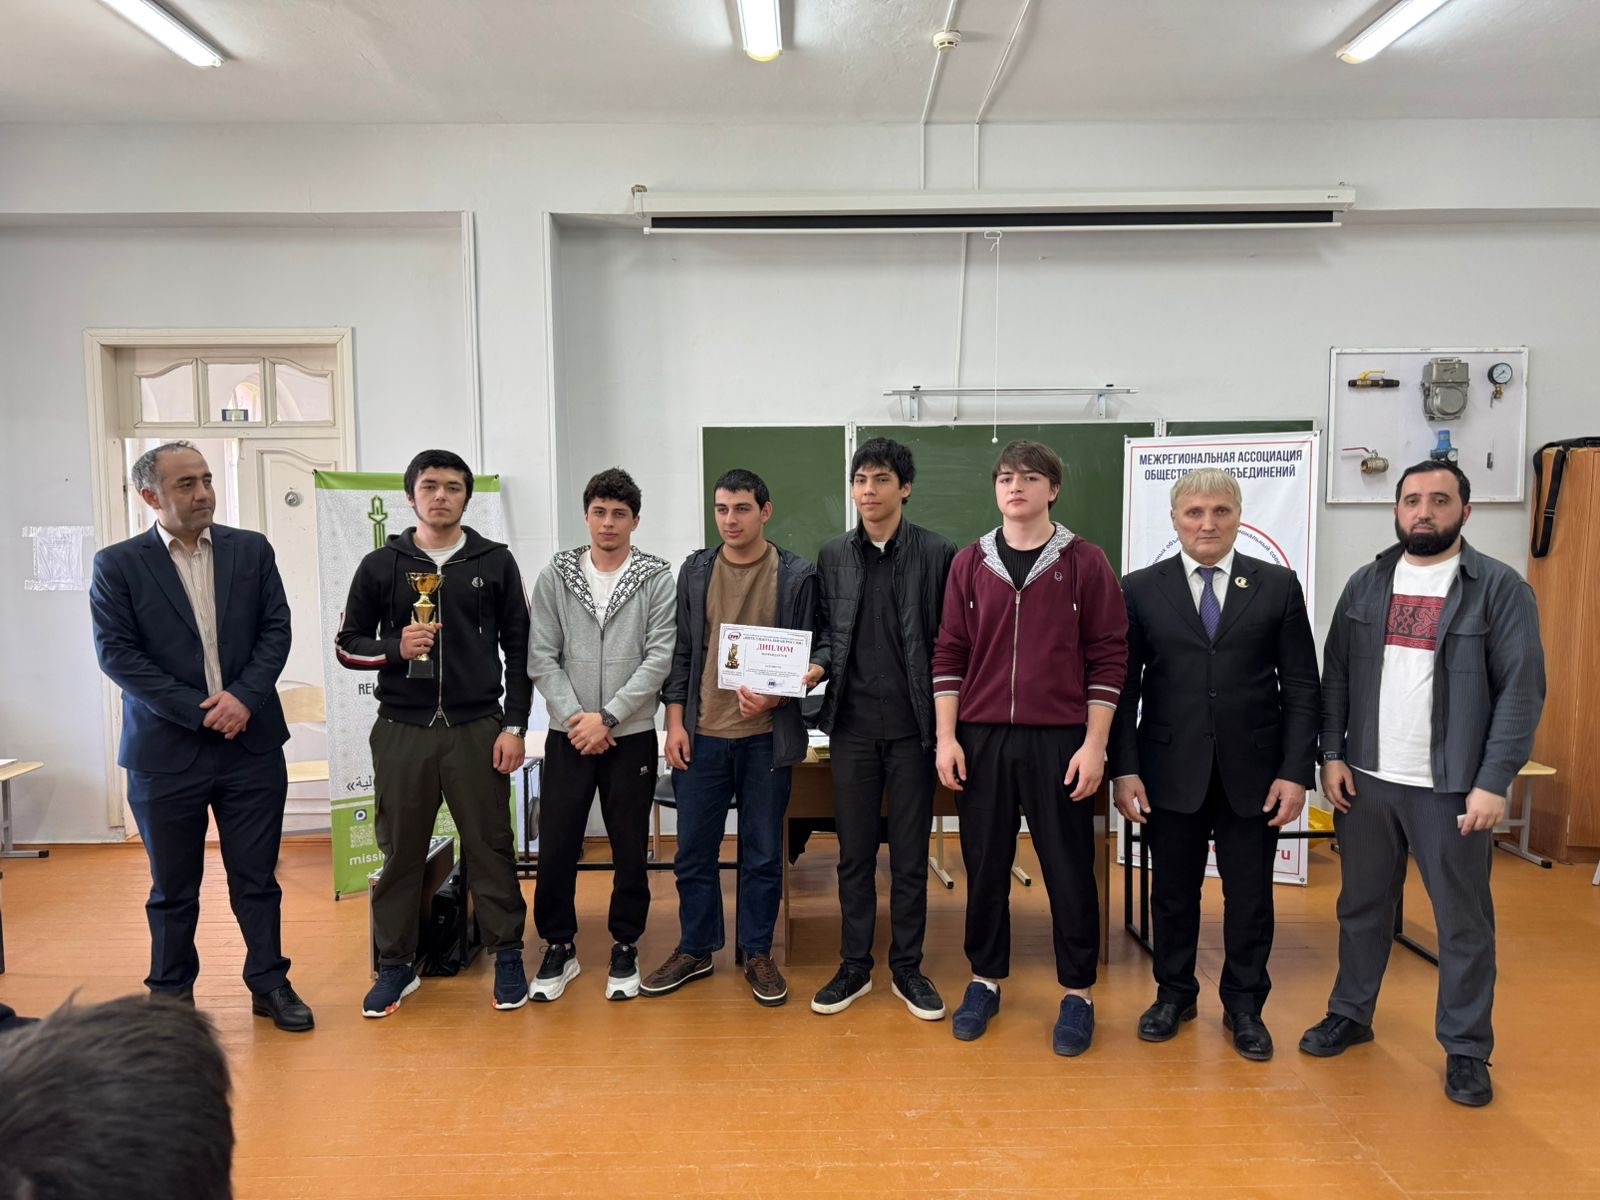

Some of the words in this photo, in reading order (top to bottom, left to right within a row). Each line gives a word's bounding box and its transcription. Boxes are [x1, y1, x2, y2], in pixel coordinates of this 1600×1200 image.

[1139, 451, 1235, 466] МЕЖРЕГИОНАЛЬНАЯ
[1238, 449, 1302, 464] АССОЦИАЦИЯ
[757, 643, 794, 653] ДИПЛОМ
